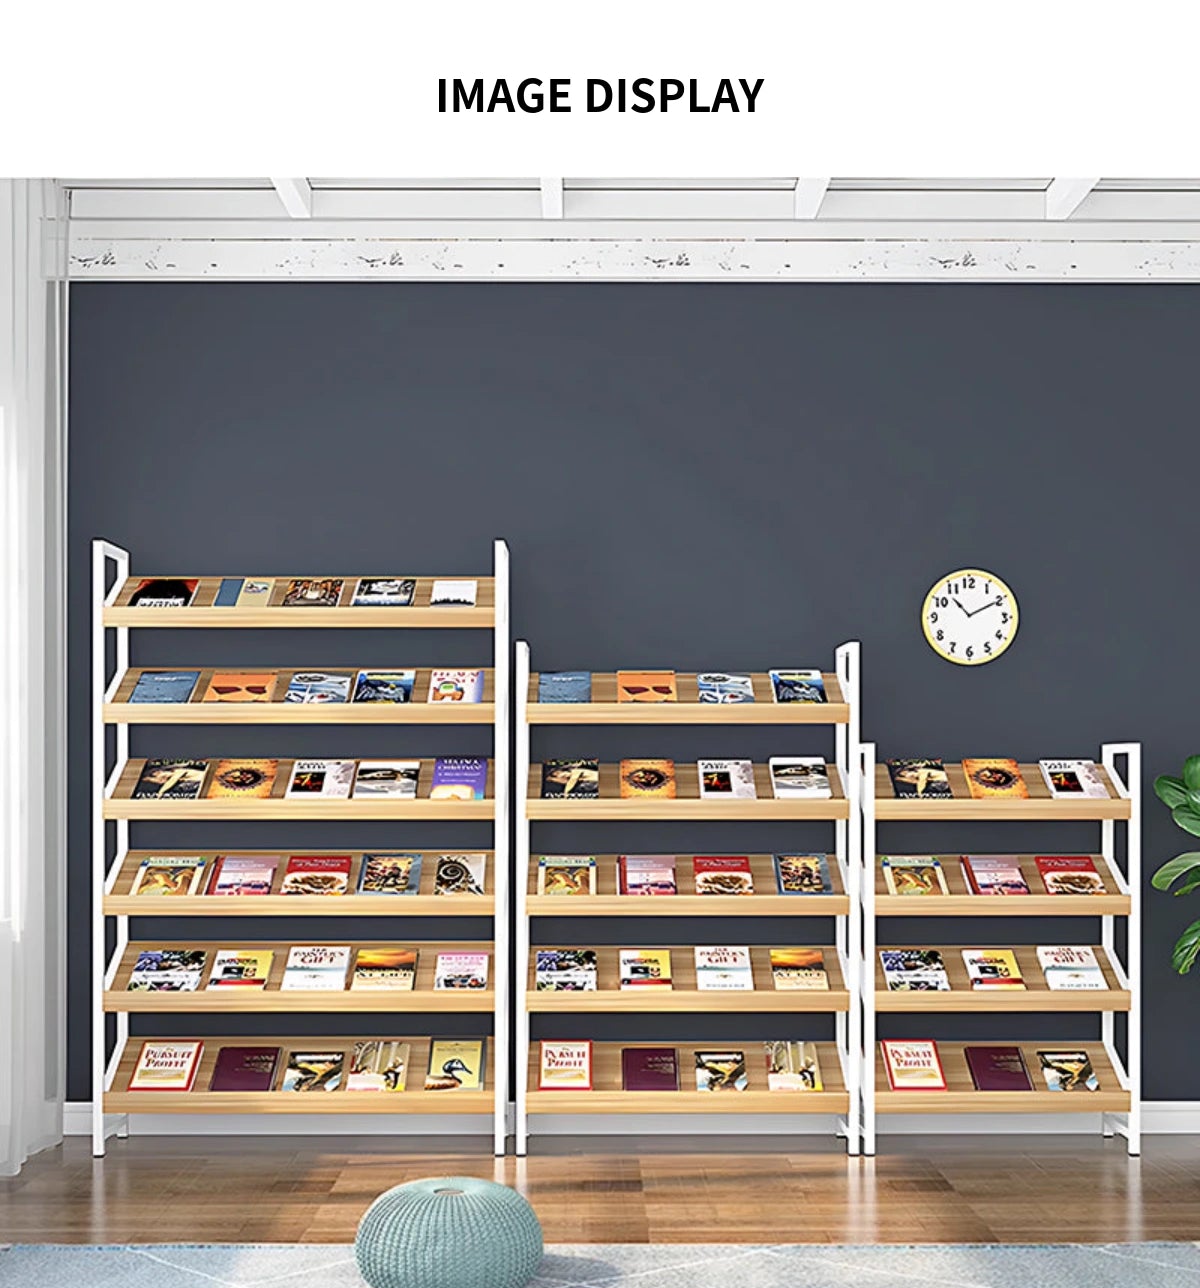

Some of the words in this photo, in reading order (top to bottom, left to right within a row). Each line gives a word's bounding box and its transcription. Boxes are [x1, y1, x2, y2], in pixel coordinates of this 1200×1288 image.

[948, 583, 959, 594] 11
[963, 577, 976, 589] 12
[935, 597, 948, 608] 10
[995, 595, 1003, 606] 2
[930, 612, 938, 623] 9
[1001, 612, 1009, 624] 3
[936, 629, 944, 641] 8
[995, 629, 1003, 640] 4
[949, 641, 957, 653] 7
[965, 646, 974, 657] 6
[983, 641, 991, 653] 5
